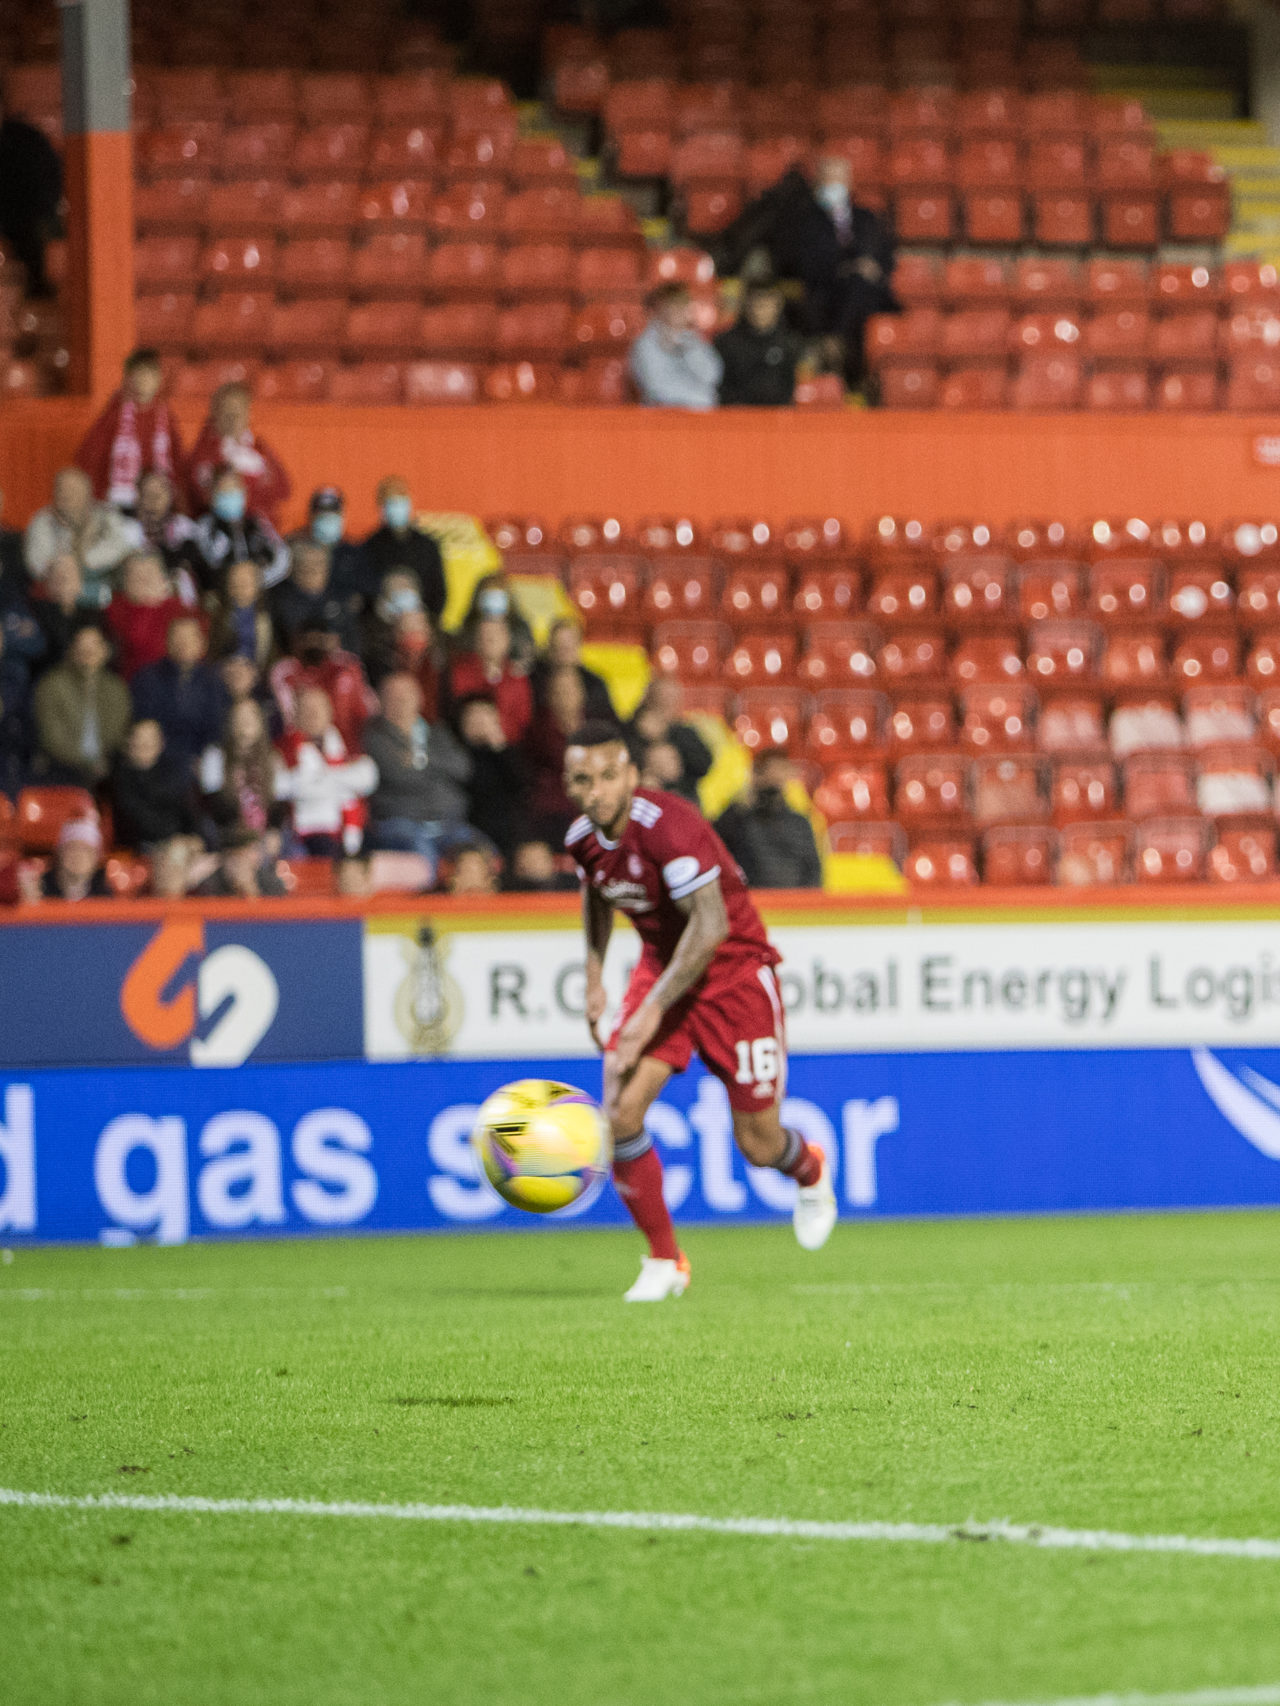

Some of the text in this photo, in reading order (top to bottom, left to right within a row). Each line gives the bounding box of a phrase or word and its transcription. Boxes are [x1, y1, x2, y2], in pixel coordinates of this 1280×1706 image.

[781, 955, 897, 1012] obal
[921, 955, 1126, 1027] Energy
[735, 1037, 777, 1084] 16
[95, 1107, 378, 1247] gas
